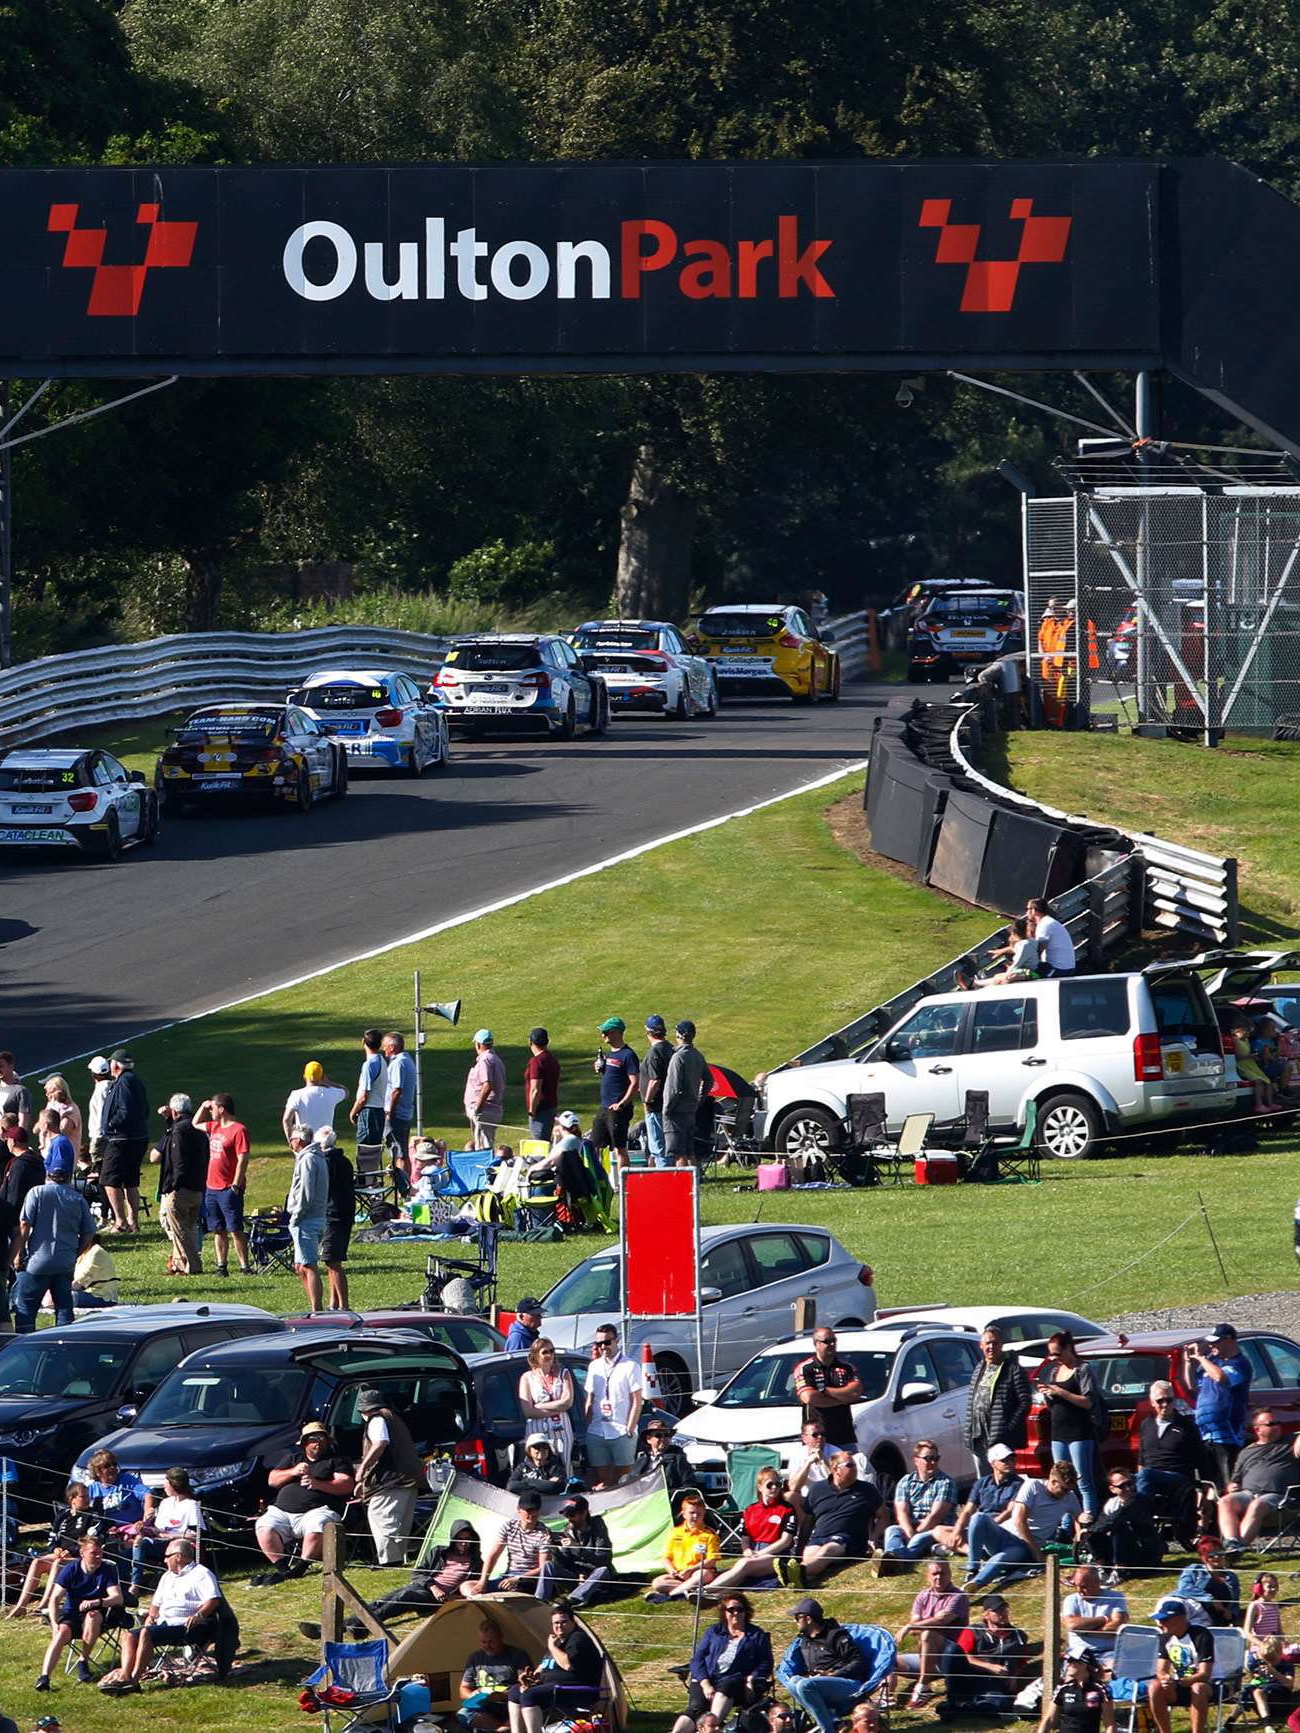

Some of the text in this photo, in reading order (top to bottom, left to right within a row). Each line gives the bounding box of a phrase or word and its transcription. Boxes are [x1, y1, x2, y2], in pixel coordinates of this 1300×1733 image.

[464, 706, 514, 714] ADRIAN FLUX
[61, 771, 75, 784] 32
